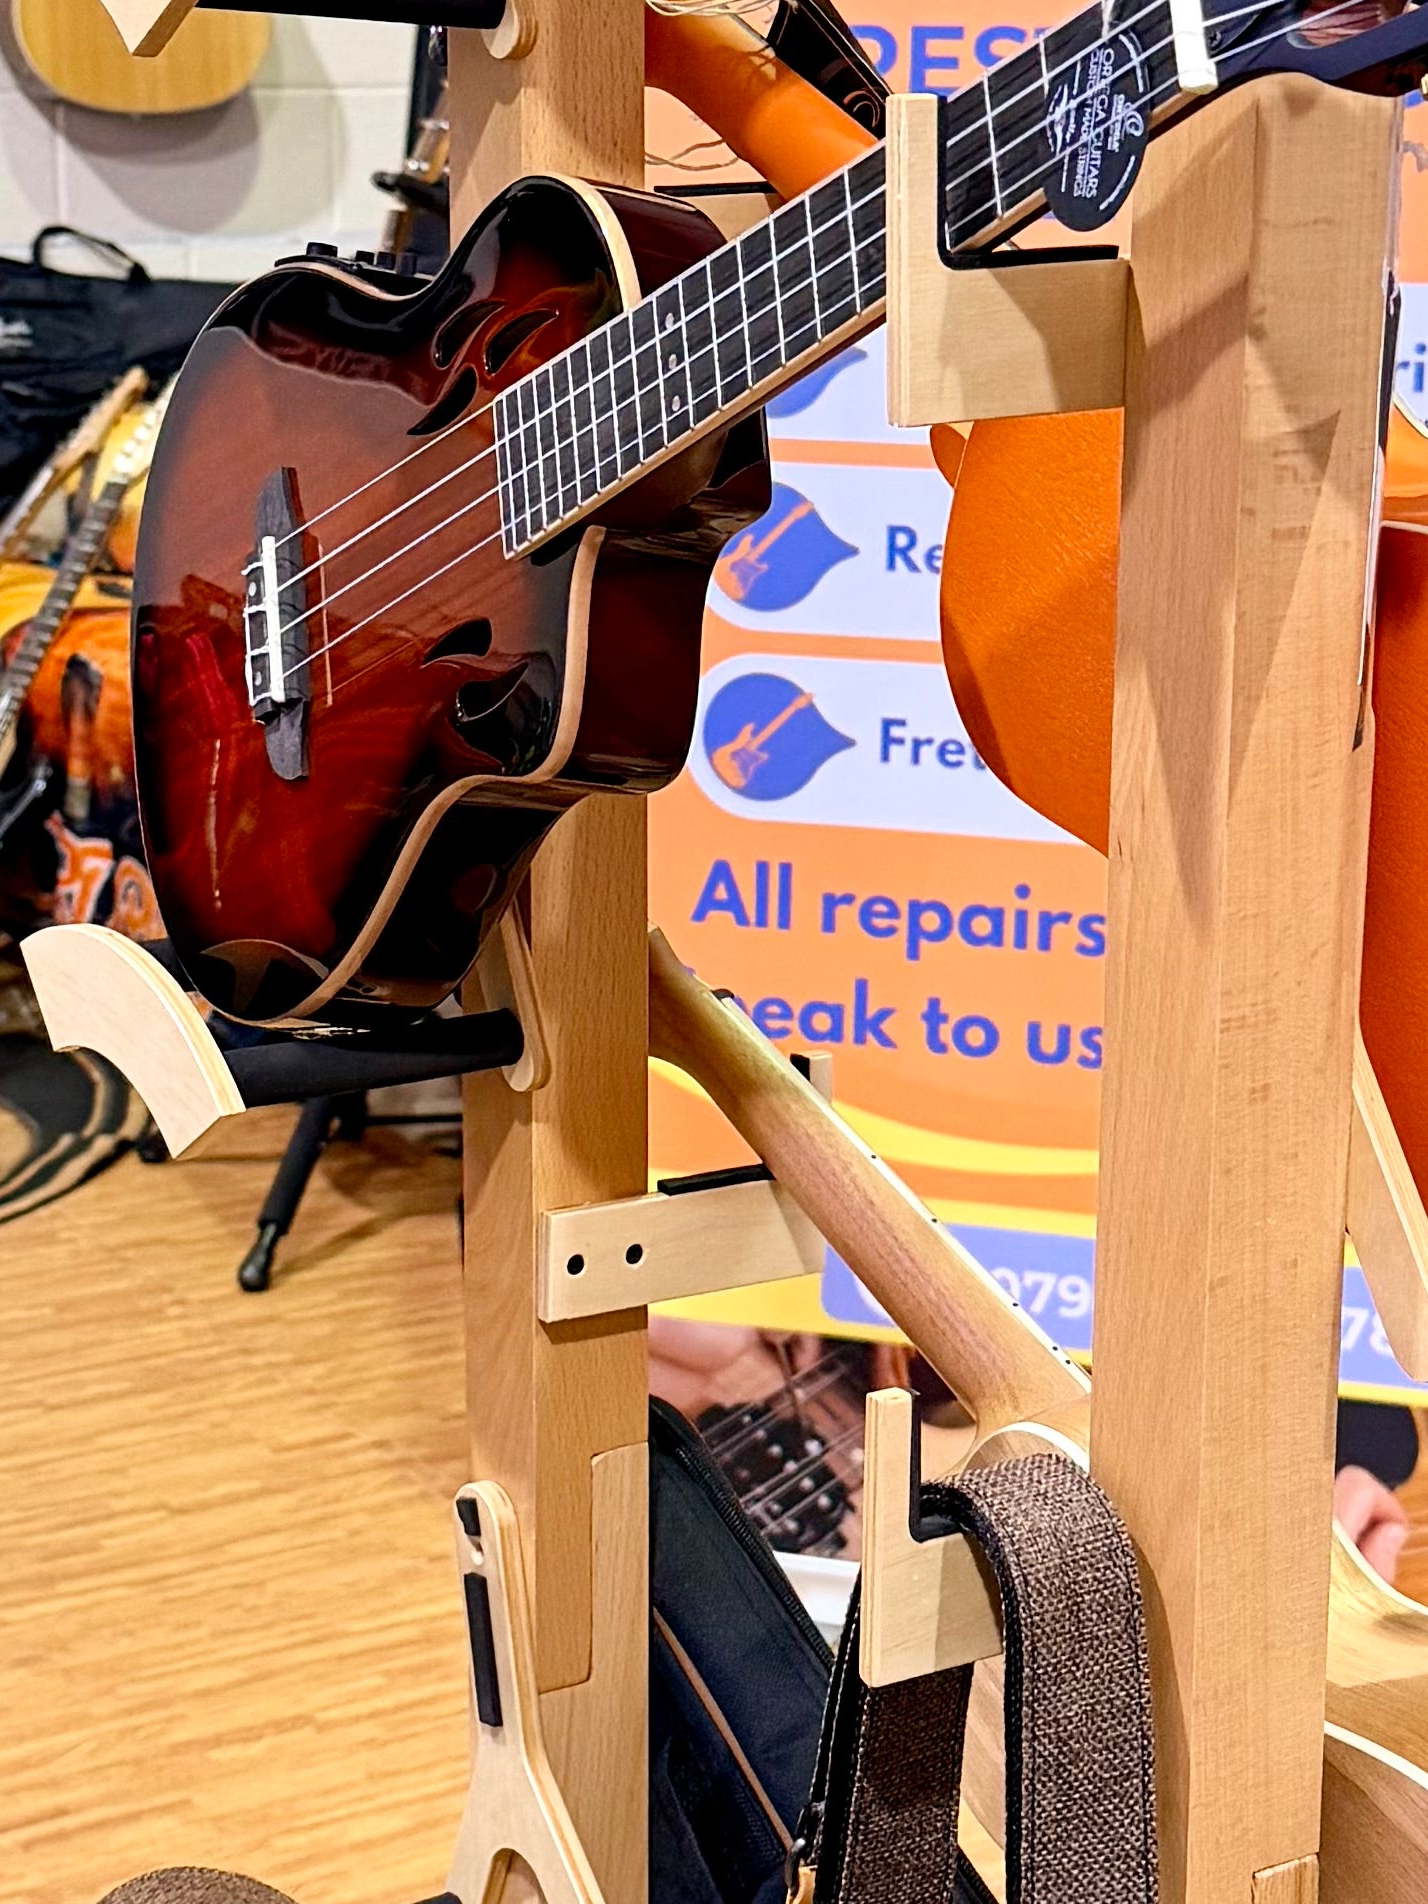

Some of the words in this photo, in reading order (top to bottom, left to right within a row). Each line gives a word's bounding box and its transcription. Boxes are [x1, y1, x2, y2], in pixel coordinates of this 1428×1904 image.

[1085, 129, 1104, 198] GUITARS
[690, 858, 793, 931] All
[820, 882, 1107, 962] repairs
[921, 996, 1000, 1059] to
[1025, 1020, 1104, 1070] us
